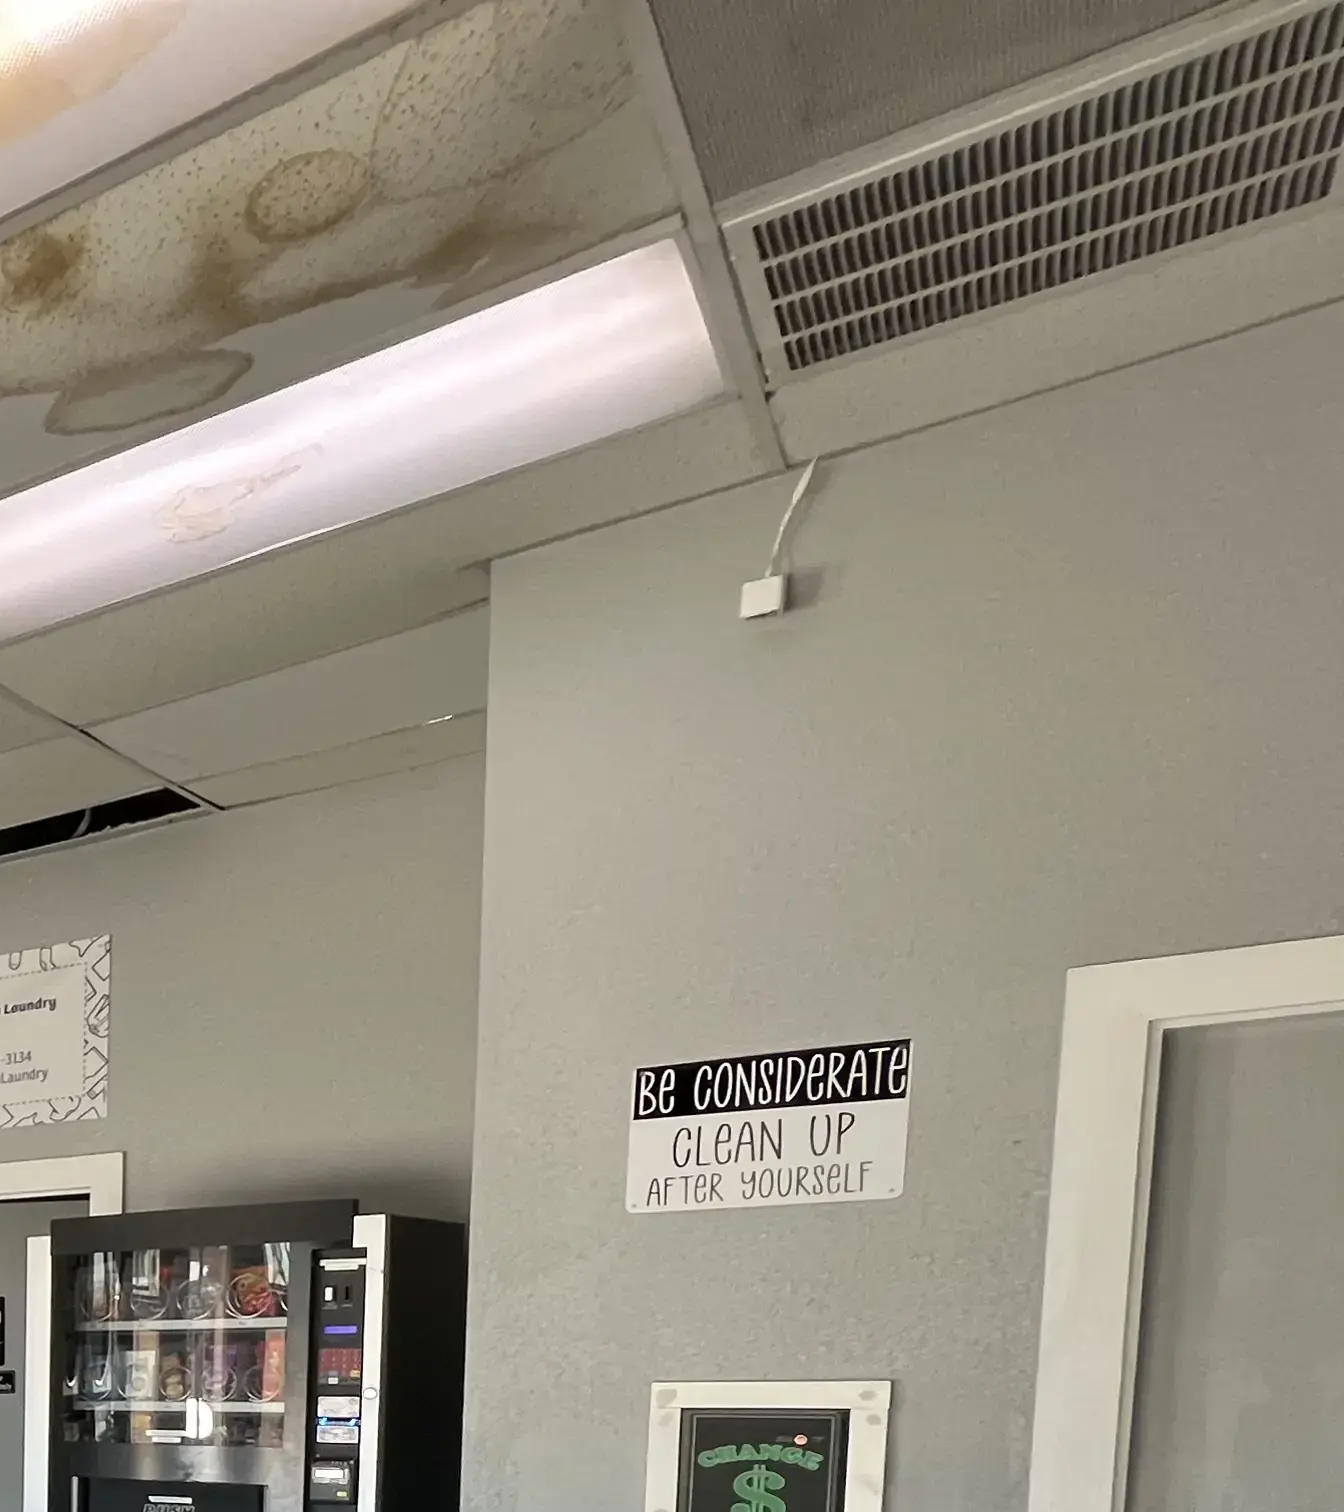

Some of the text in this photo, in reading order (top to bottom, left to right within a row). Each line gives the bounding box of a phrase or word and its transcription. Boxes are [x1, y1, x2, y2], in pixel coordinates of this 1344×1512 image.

[3, 996, 58, 1017] Laundry
[693, 1046, 908, 1111] CONSIDERATE
[672, 1112, 855, 1168] CLEAN UP
[646, 1161, 873, 1207] AFTER YOURSELF
[697, 1443, 825, 1472] CHANGE
